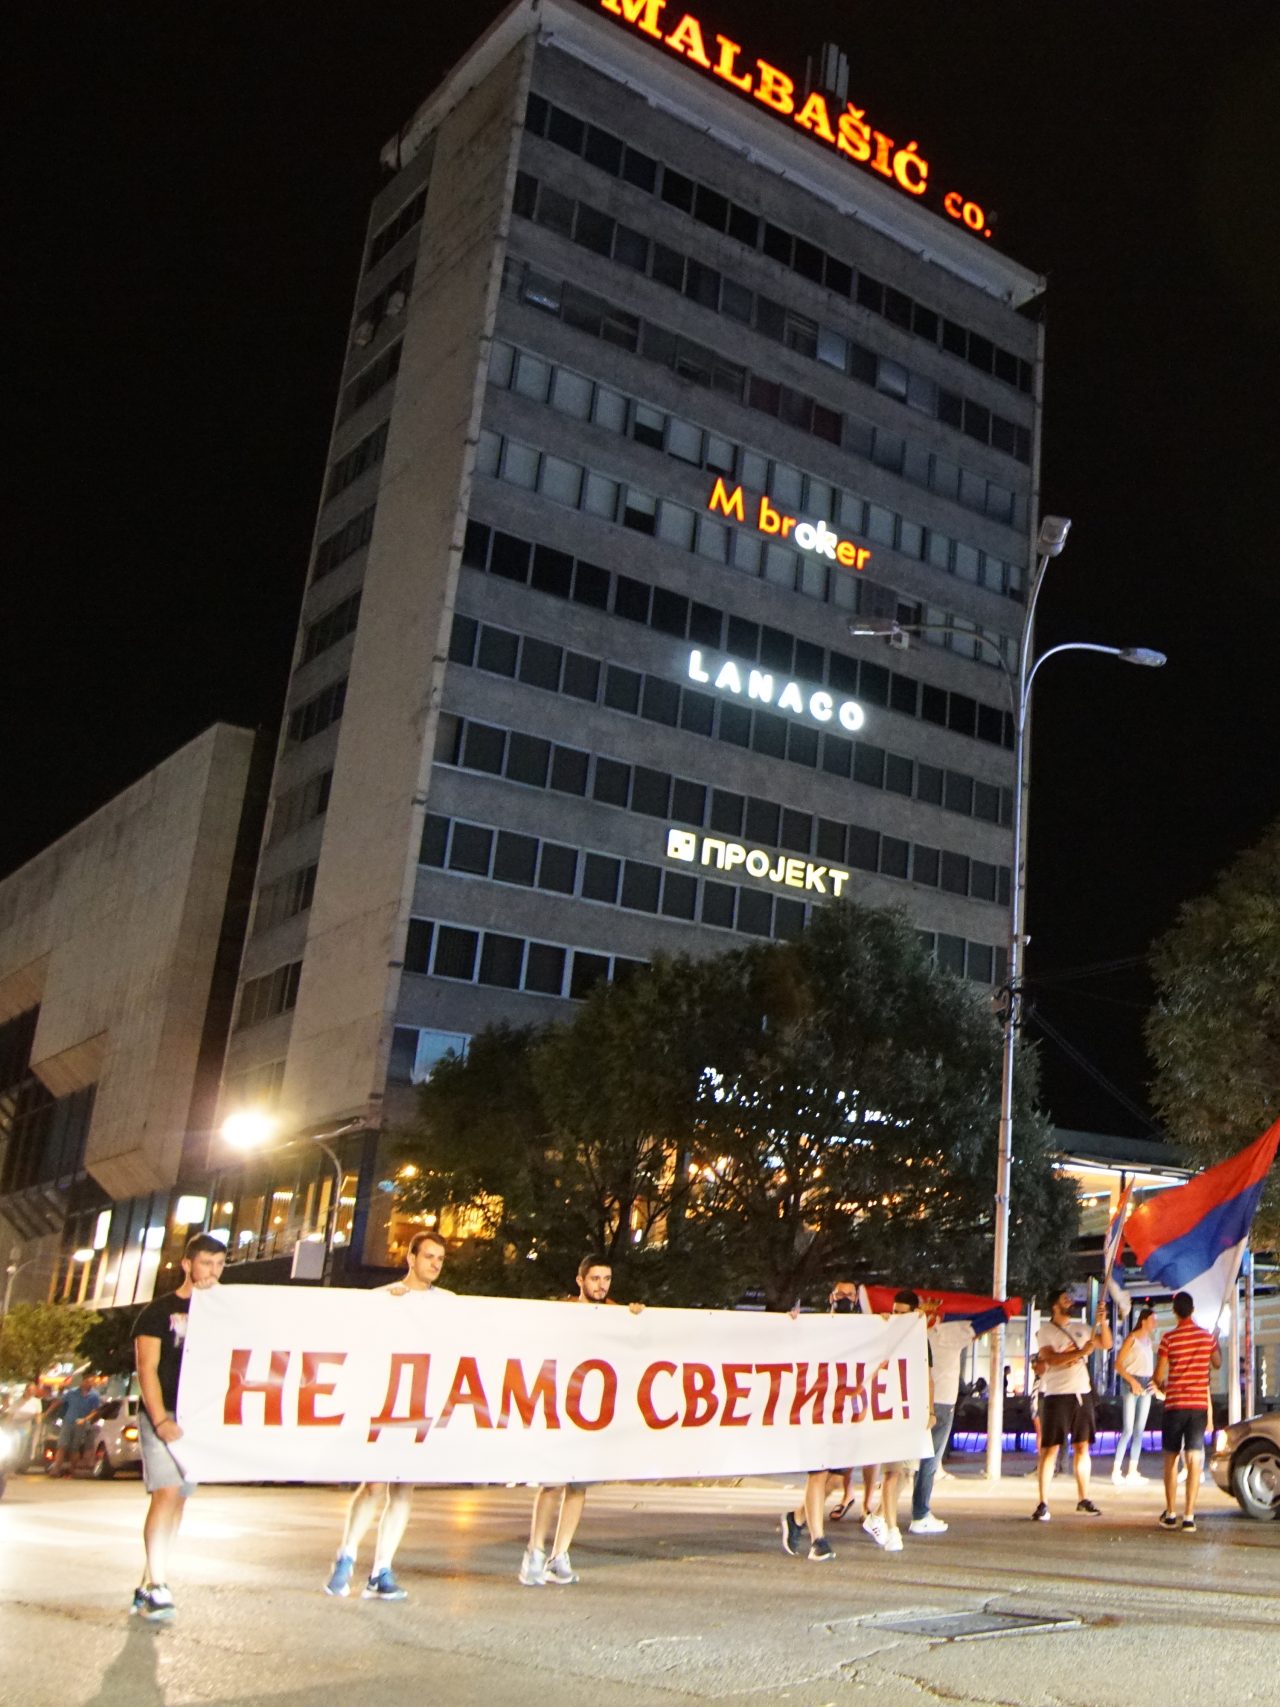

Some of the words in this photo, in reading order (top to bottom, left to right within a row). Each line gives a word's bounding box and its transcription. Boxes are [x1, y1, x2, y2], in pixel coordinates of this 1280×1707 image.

[600, 0, 930, 195] MALBAŠIĆ
[708, 477, 745, 522] M
[758, 496, 872, 570] broker
[688, 649, 865, 732] LANACO
[701, 838, 850, 897] ПРОЈЕКТ
[223, 1349, 347, 1426] НЕ
[367, 1352, 619, 1444] ДАМО
[636, 1359, 910, 1431] СВЕТИЊЕ!
